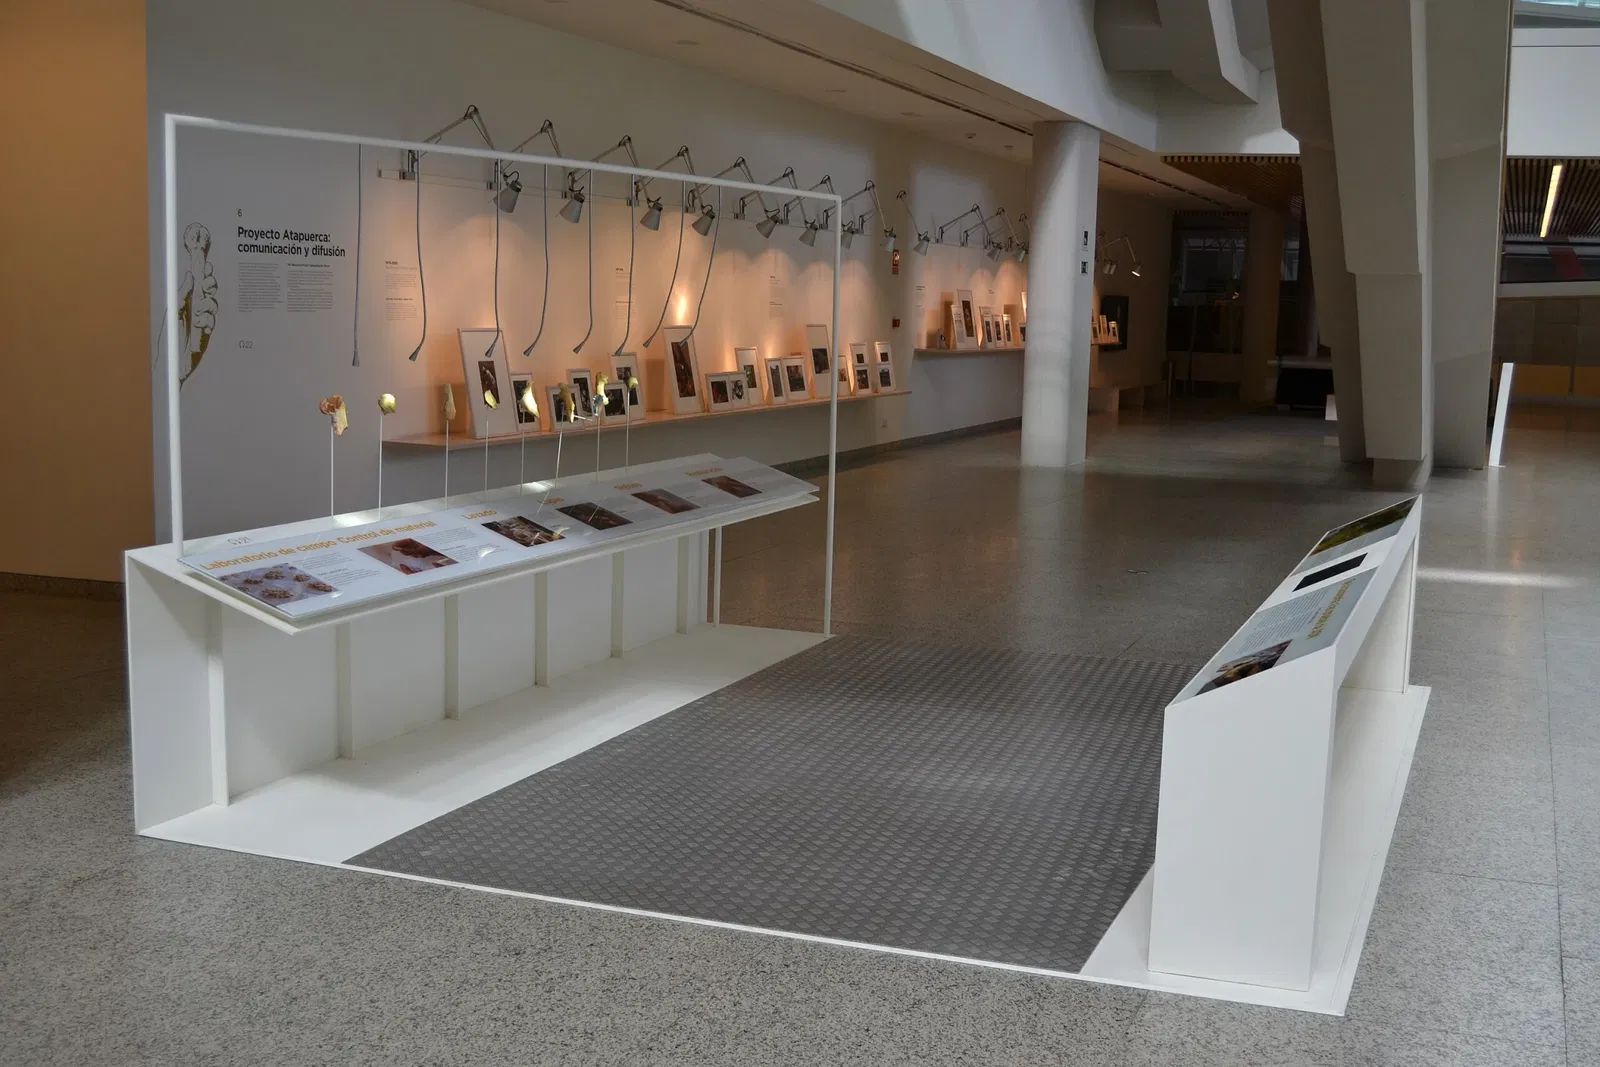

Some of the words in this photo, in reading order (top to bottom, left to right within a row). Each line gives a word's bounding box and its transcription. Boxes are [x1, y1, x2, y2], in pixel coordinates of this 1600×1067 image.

[237, 208, 243, 217] 6
[237, 226, 281, 241] Proyecto
[282, 229, 331, 243] Atapuerca:
[237, 243, 302, 255] comunicación
[304, 246, 310, 257] y
[311, 244, 346, 257] difusión
[201, 551, 277, 570] Laboratorio
[278, 547, 296, 555] de
[337, 531, 380, 544] Control
[379, 528, 394, 536] de
[394, 520, 437, 533] material
